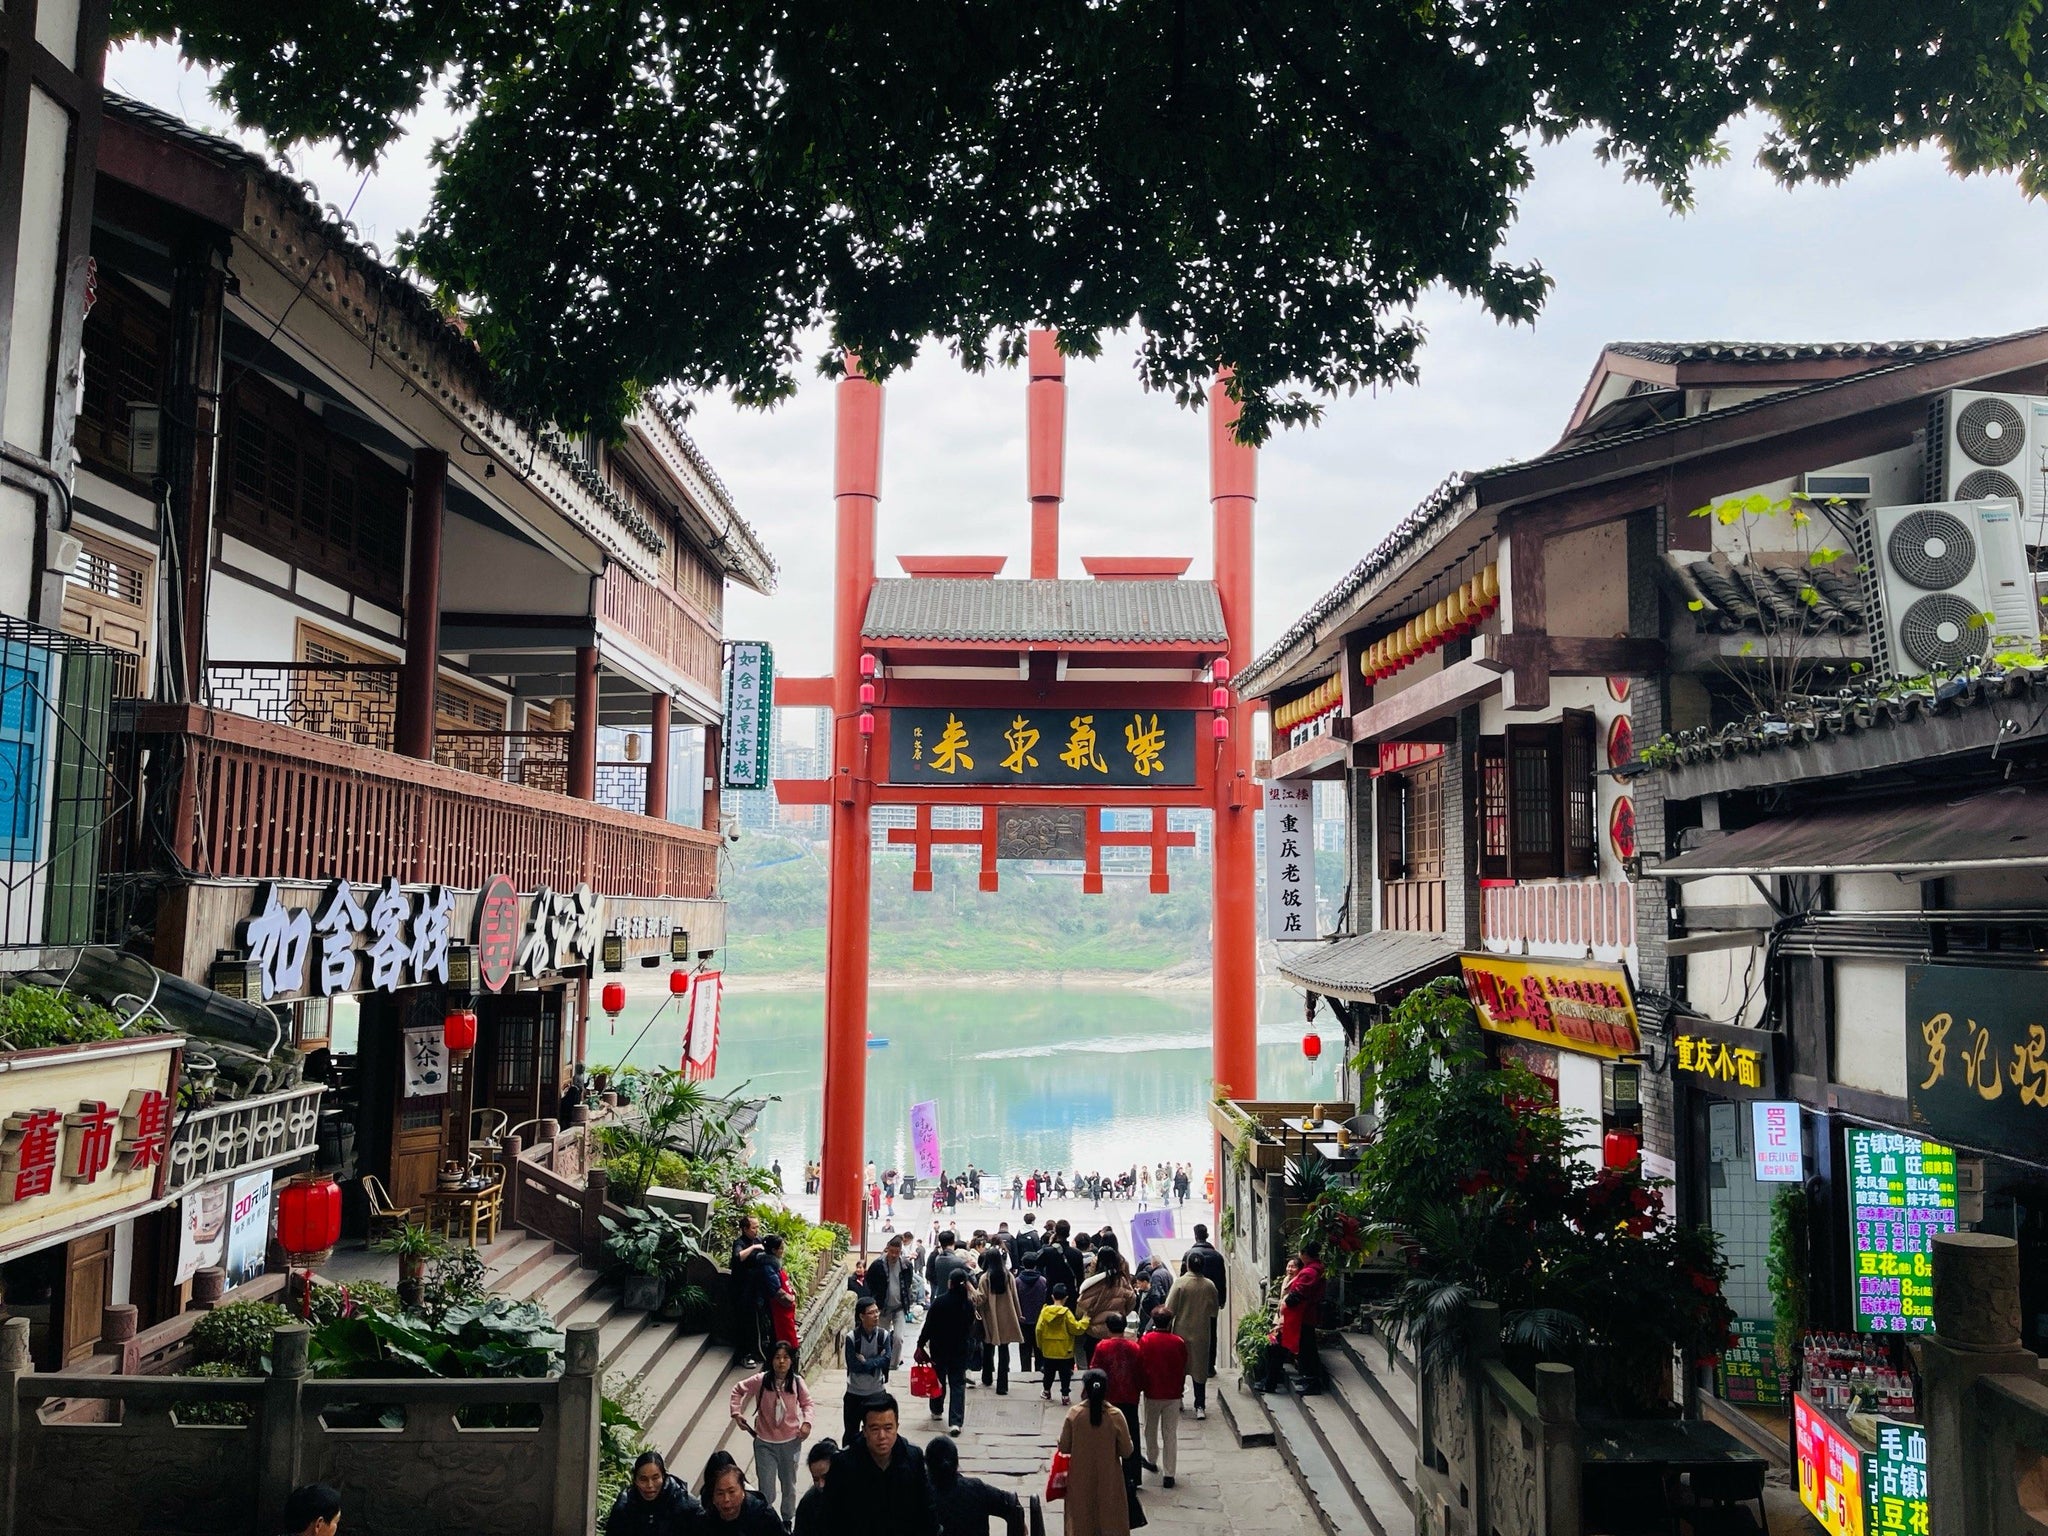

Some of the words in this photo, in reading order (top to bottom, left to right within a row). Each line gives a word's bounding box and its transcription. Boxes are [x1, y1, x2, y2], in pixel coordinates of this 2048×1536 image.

[733, 651, 757, 778] 如舍江景客栈
[1280, 813, 1302, 932] 重庆老饭店
[247, 876, 456, 1000] 如舍客栈
[413, 1037, 440, 1067] 茶
[1675, 1034, 1761, 1088] 重庆小面
[1767, 1108, 1786, 1146] 罗记
[1853, 1132, 1921, 1154] 古镇鸡杂
[1854, 1154, 1922, 1174] 毛血旺
[234, 1181, 269, 1223] 20元/位
[1906, 1192, 1940, 1206] 辣子鸡
[1859, 1252, 1898, 1275] 豆花
[1859, 1276, 1900, 1295] 重庆小面
[1871, 1316, 1937, 1331] 承接订
[1882, 1496, 1929, 1536] 豆花
